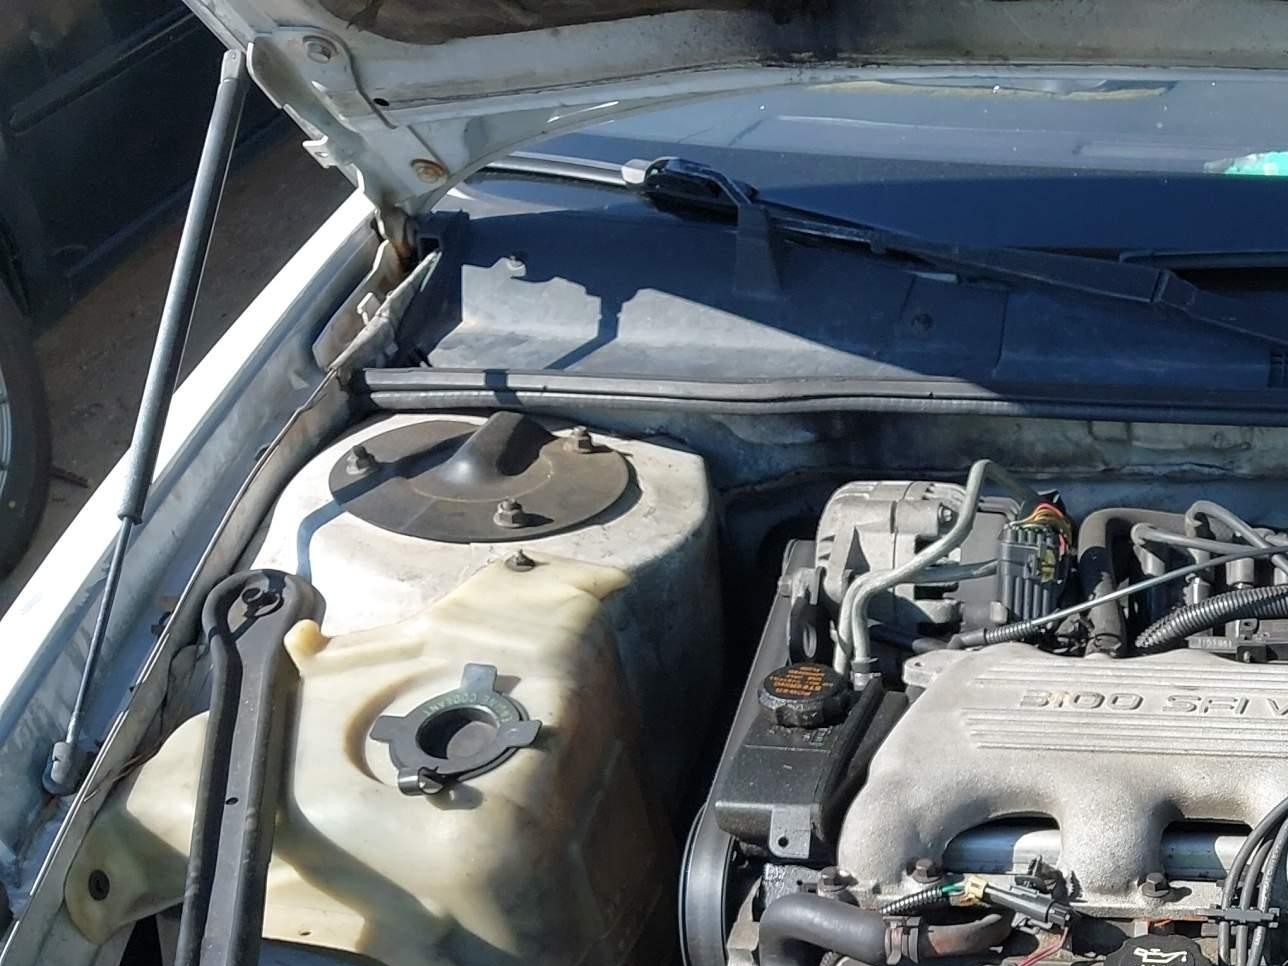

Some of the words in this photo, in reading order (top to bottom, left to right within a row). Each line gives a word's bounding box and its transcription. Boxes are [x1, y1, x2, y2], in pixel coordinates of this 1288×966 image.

[423, 692, 478, 715] COOLANT
[1020, 689, 1144, 711] 3100
[1162, 694, 1250, 716] SFI
